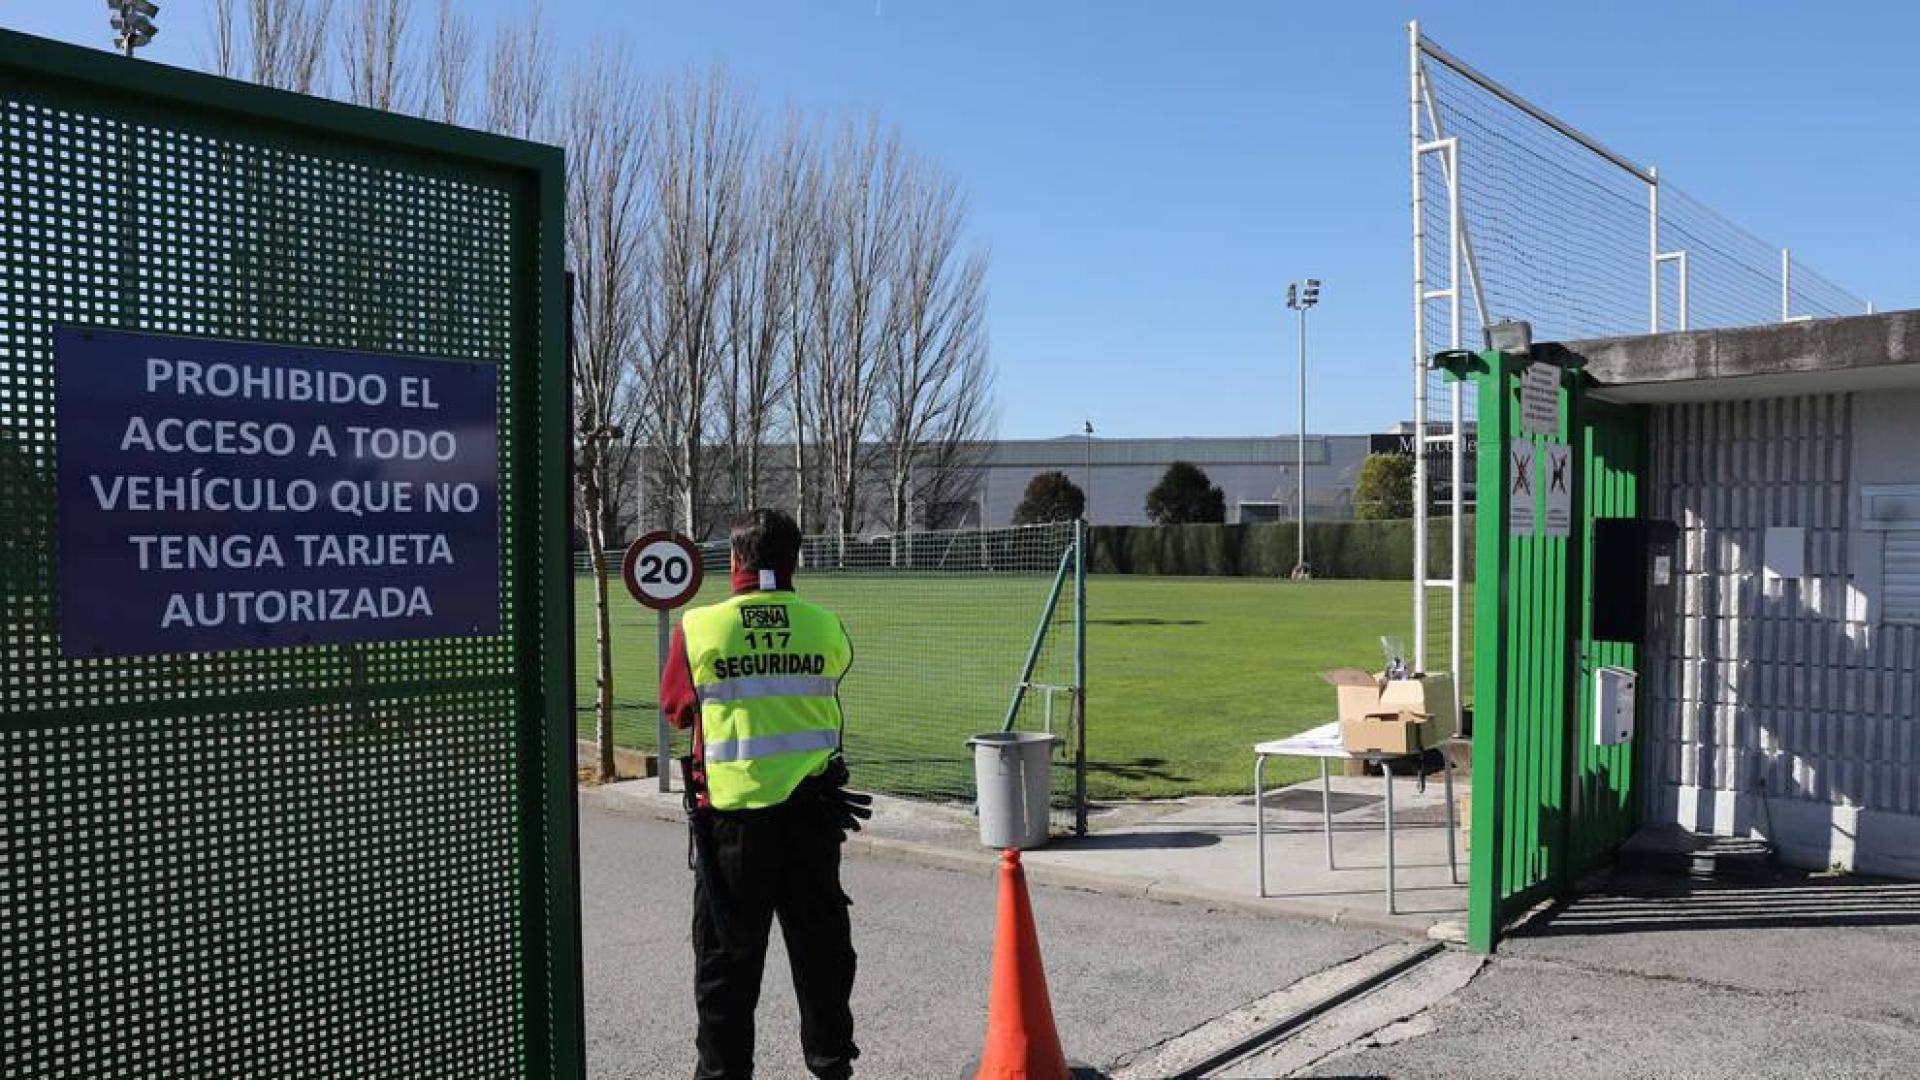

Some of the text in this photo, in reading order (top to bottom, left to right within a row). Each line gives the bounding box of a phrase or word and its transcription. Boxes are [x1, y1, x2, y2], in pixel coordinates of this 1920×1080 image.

[147, 358, 439, 409] PROHIBIDO EL
[121, 416, 457, 462] ACCESO A TODO
[90, 468, 479, 517] VEHÍCULO QUE NO
[129, 534, 454, 570] TENGA TARJETA
[640, 555, 689, 585] 20
[161, 587, 433, 628] AUTORIZADA
[744, 631, 792, 650] 117
[713, 653, 825, 679] SEGURIDAD
